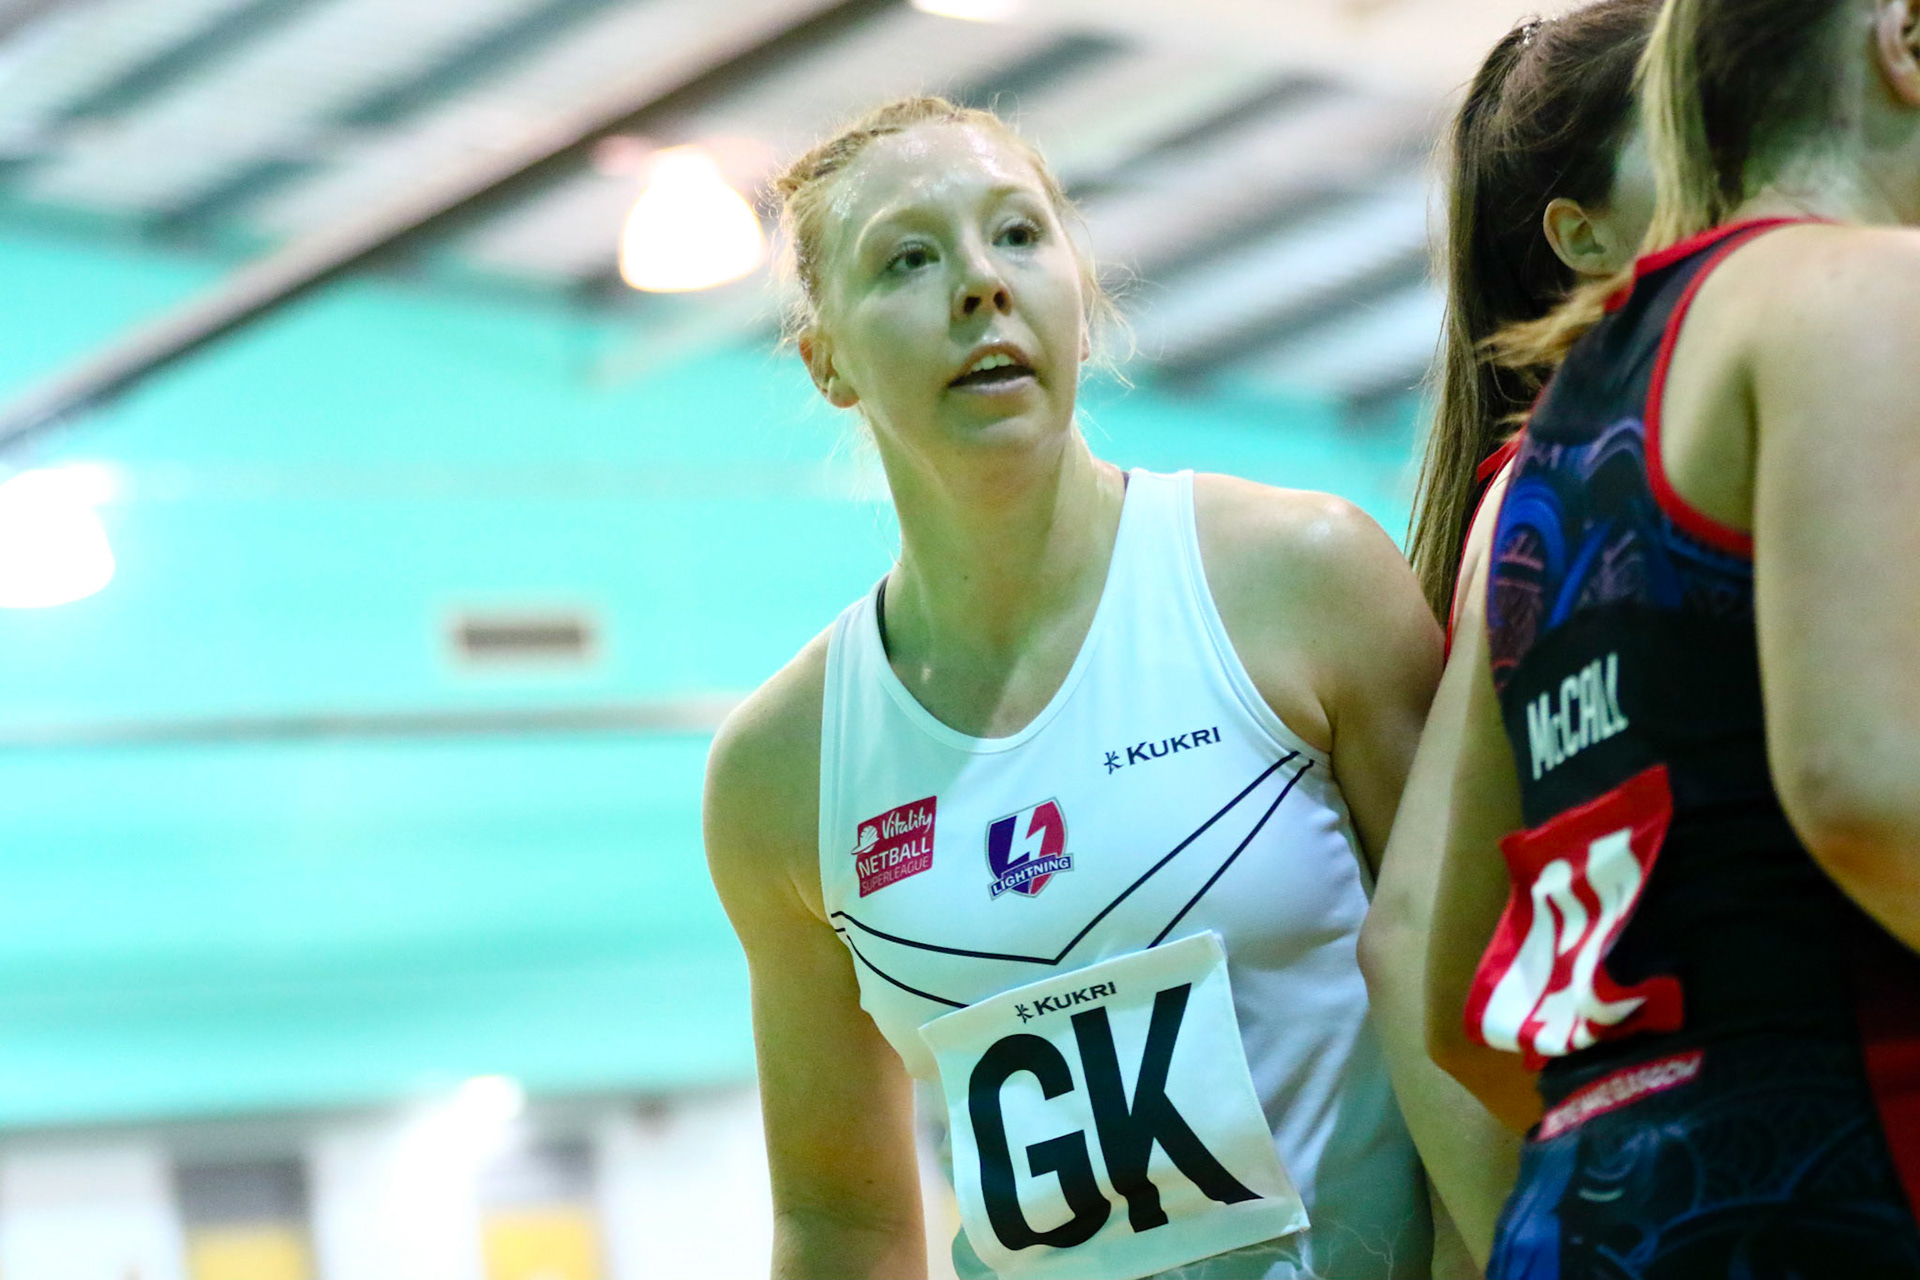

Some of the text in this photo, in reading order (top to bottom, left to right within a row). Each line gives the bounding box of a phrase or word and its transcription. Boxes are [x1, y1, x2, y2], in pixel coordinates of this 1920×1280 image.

[1126, 726, 1221, 766] KUKRI
[882, 807, 933, 839] Vitality
[858, 838, 931, 879] NETBALL
[861, 856, 930, 895] SUPERLEAGUE
[992, 857, 1070, 895] LIGHTNING
[1033, 981, 1118, 1016] KUKRI
[968, 982, 1264, 1251] GK
